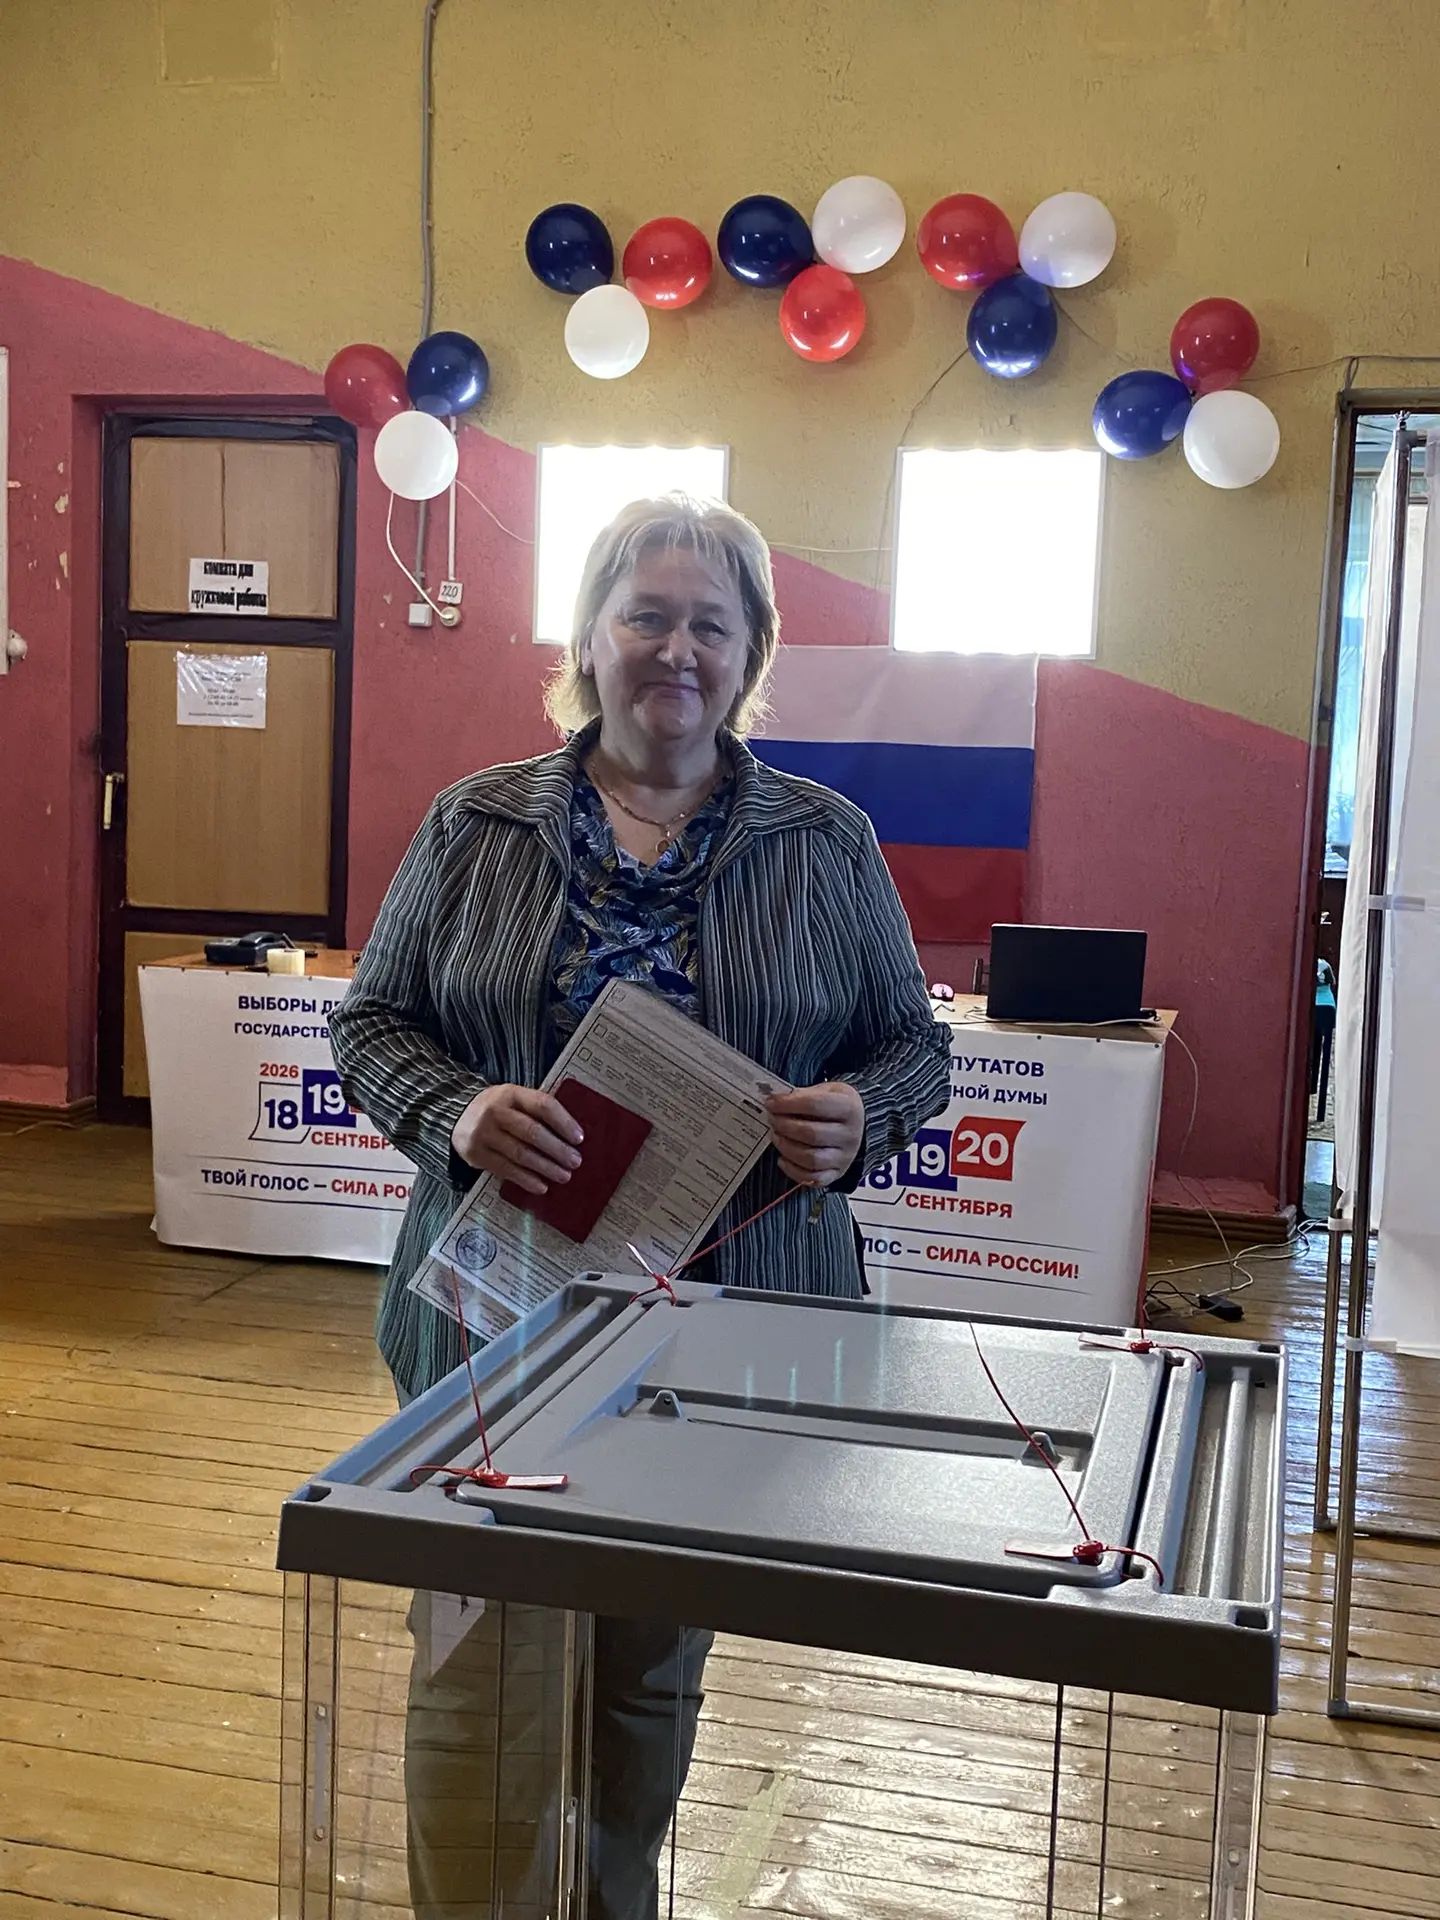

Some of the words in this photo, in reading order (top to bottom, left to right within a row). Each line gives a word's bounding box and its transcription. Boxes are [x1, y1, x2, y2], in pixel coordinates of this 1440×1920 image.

[441, 585, 458, 598] 220
[238, 996, 316, 1013] ВЫБОРЫ
[234, 1023, 330, 1039] ГОСУДАРСТВ
[259, 1063, 299, 1079] 2026
[949, 1084, 989, 1100] НОЙ
[993, 1089, 1047, 1105] ДУМЫ
[264, 1098, 299, 1130] 18
[308, 1083, 346, 1115] 19
[311, 1132, 396, 1150] СЕНТЯБР
[905, 1142, 946, 1177] 19
[956, 1130, 1009, 1166] 20
[201, 1169, 246, 1187] ТВОЙ
[251, 1174, 309, 1191] ГОЛОС
[331, 1179, 378, 1197] СИЛА
[906, 1193, 1012, 1218] СЕНТЯБРЯ
[926, 1245, 981, 1266] СИЛА
[987, 1253, 1079, 1279] РОССИИ!
